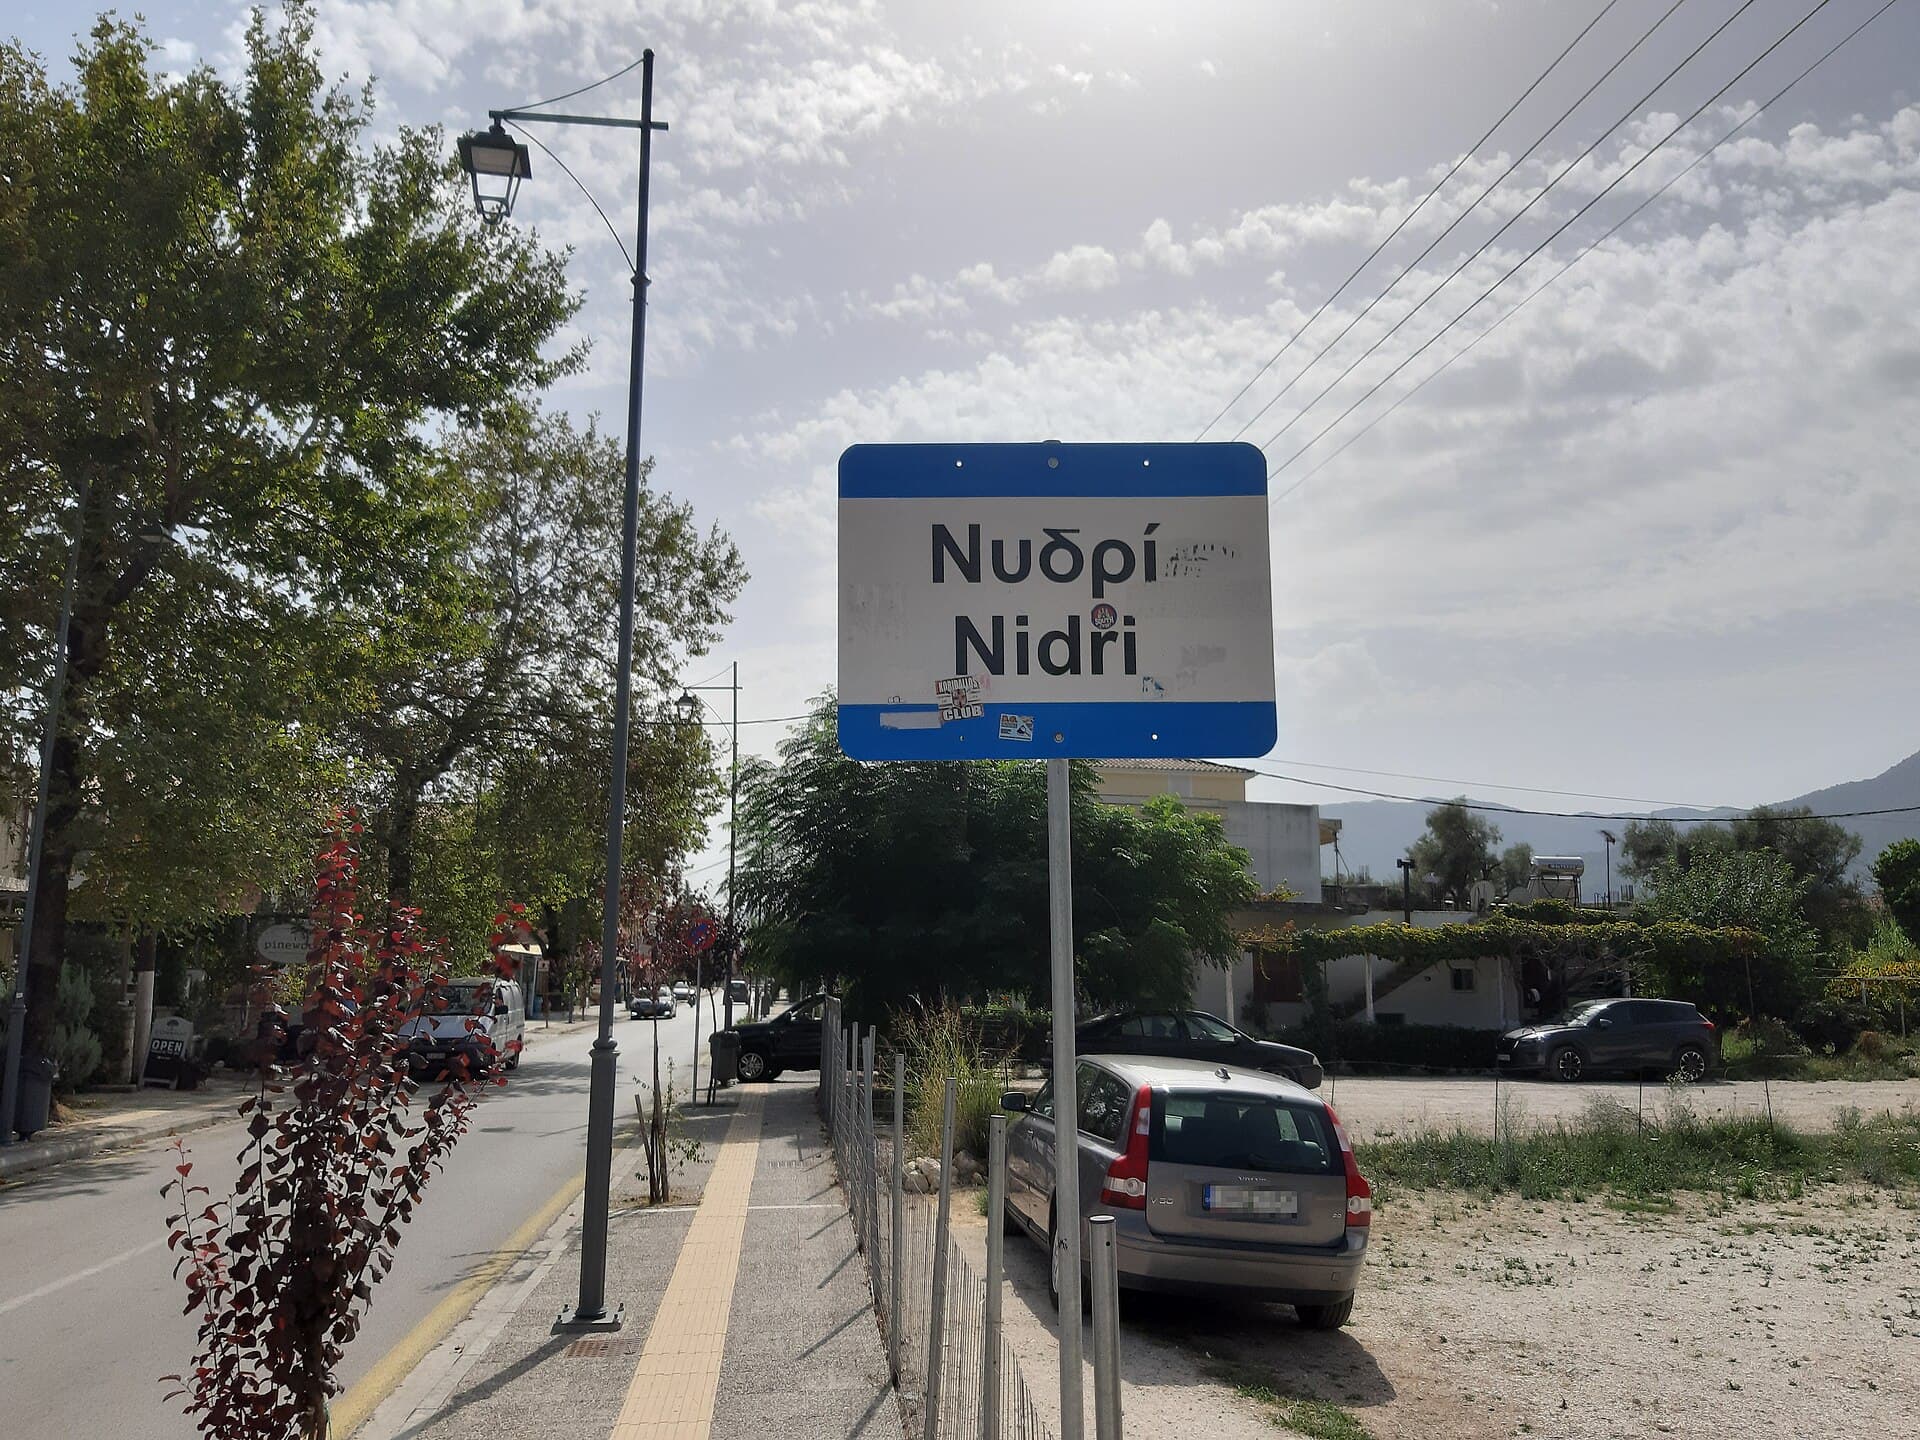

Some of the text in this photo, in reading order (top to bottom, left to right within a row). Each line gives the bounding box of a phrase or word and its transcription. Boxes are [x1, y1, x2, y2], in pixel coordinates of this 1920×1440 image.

[932, 523, 1160, 599] Νυδρί
[955, 615, 1137, 676] Nidri
[943, 704, 983, 721] CLUB
[263, 940, 312, 951] pinewo
[152, 1039, 183, 1052] OPEN
